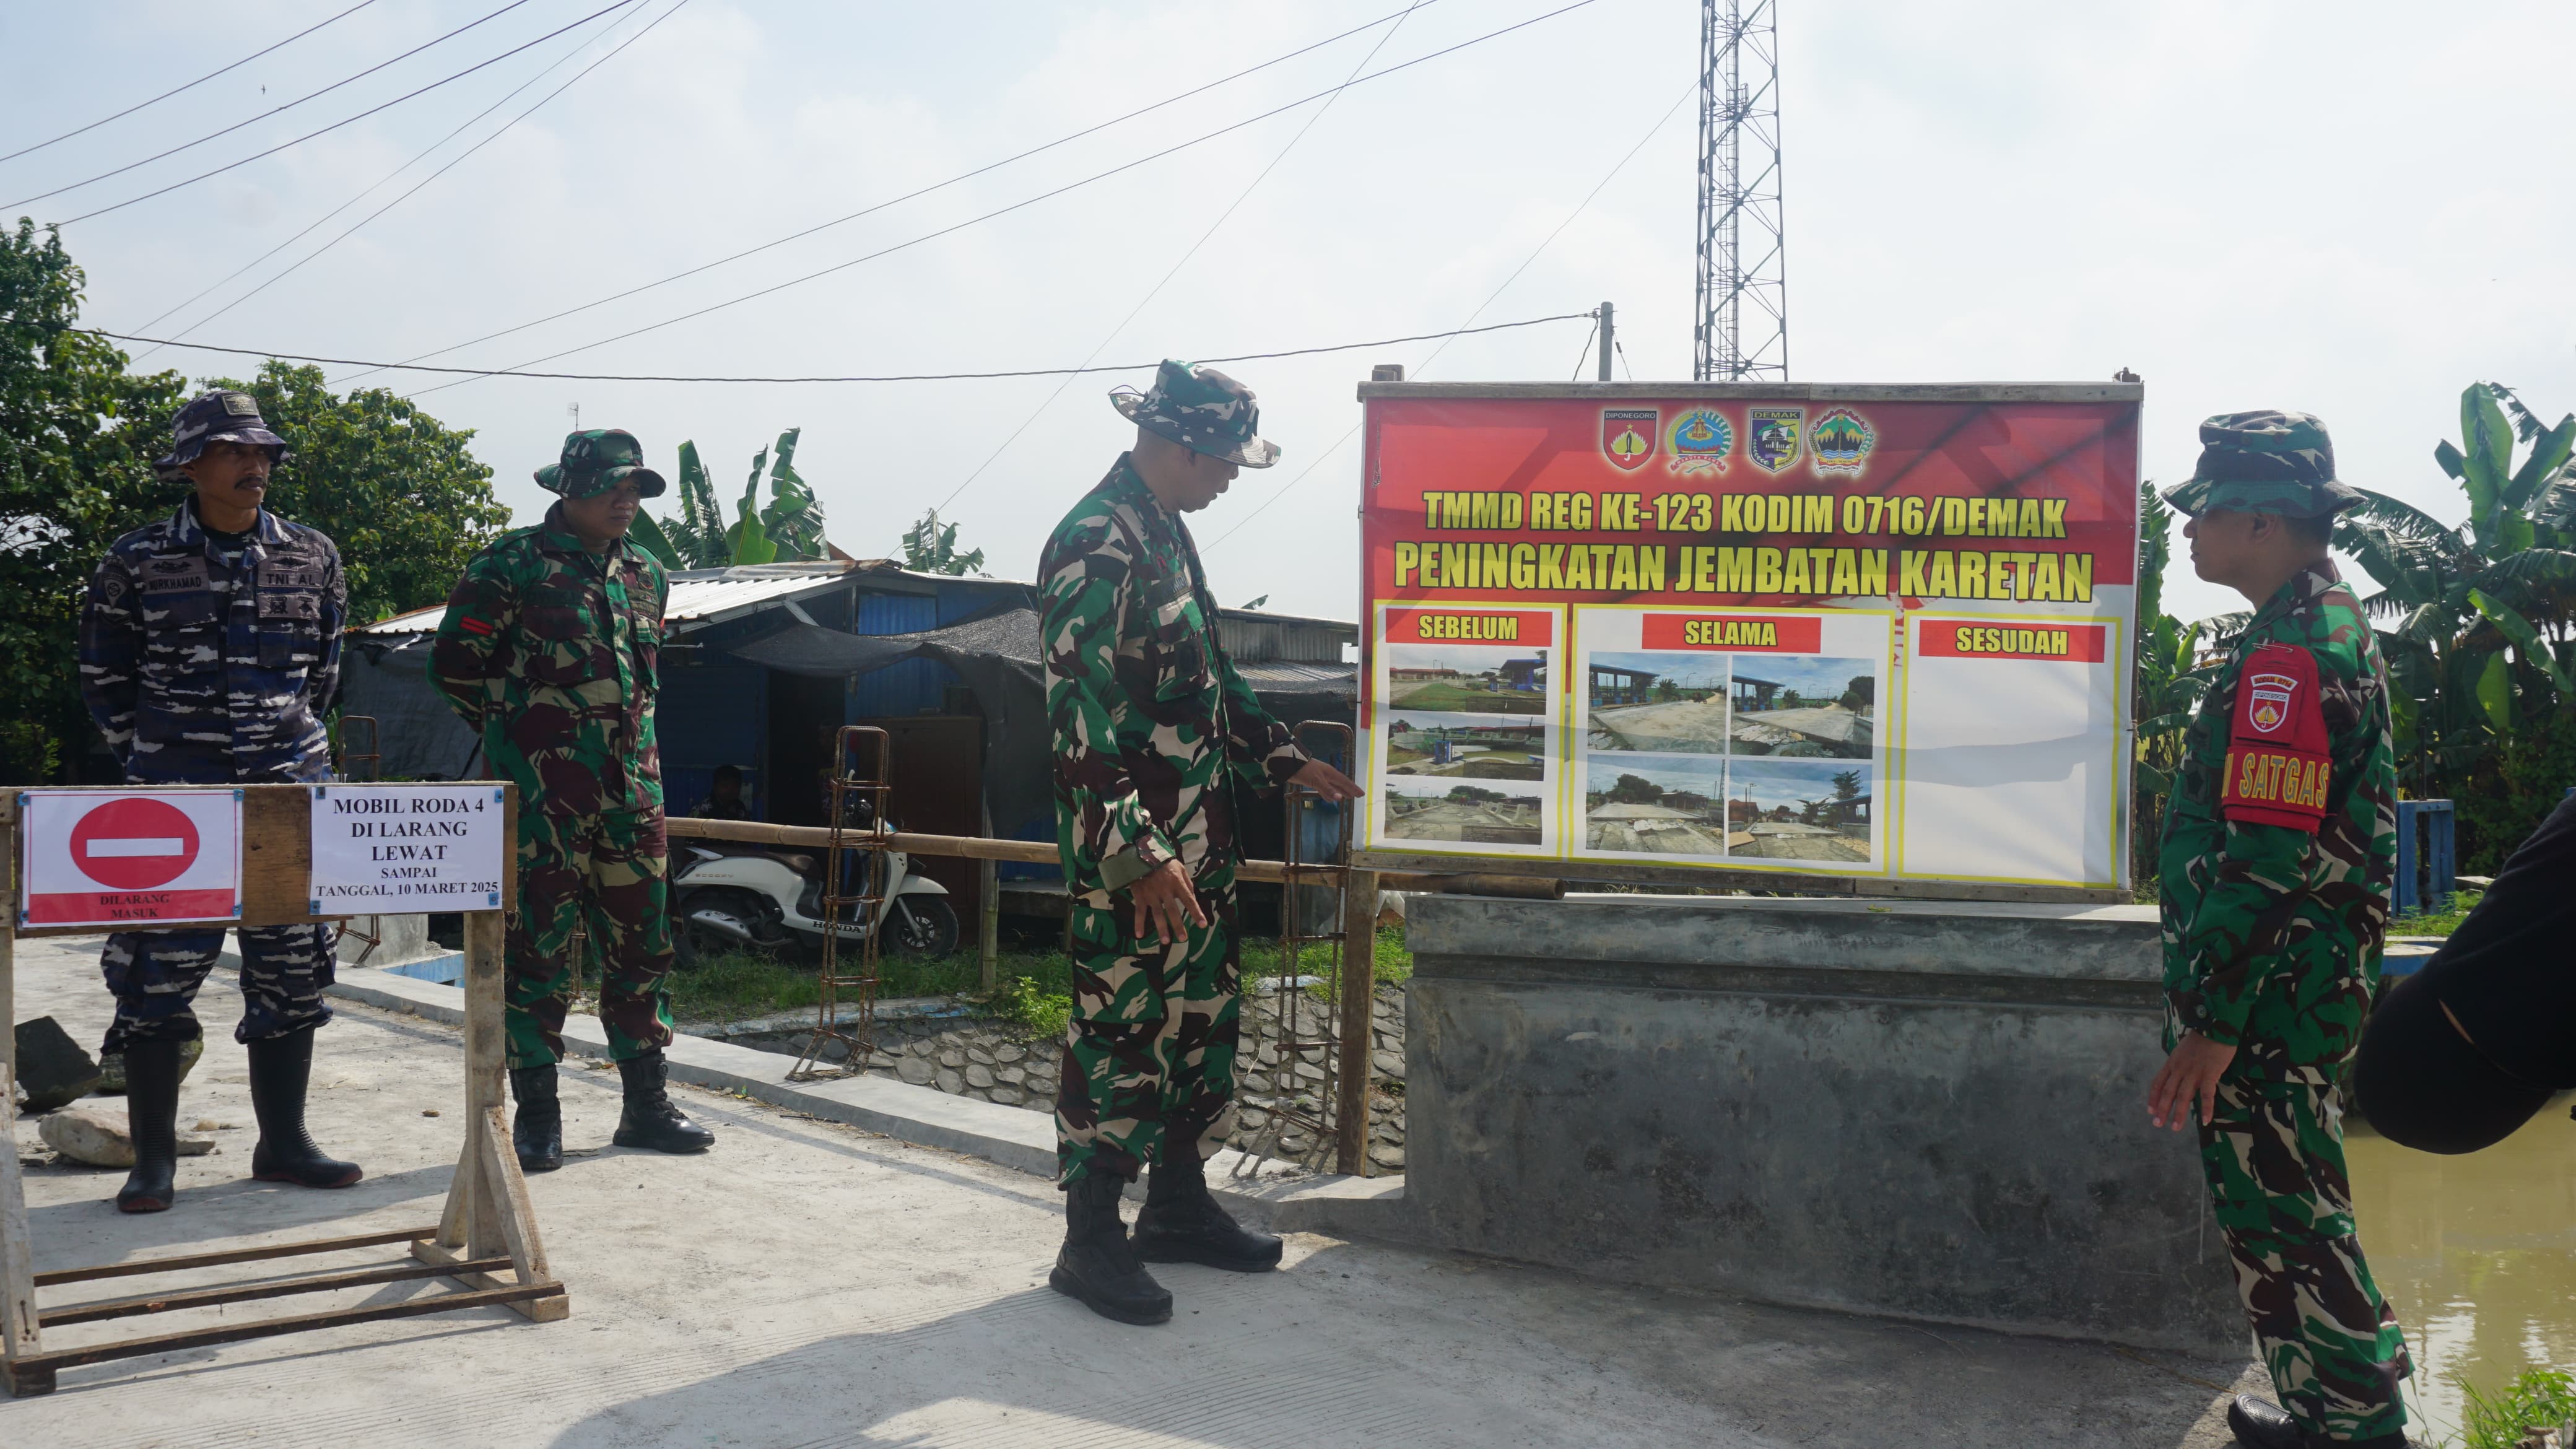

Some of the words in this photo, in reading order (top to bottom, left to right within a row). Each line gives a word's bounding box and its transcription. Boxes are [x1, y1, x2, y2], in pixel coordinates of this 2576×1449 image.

[1605, 412, 1656, 420] DIPONEGORO
[1754, 411, 1798, 419] DEMAK
[1422, 492, 1524, 529] TMMD
[1530, 493, 1593, 531] REG
[1600, 493, 1713, 533] KE-123
[1721, 494, 1834, 534] KODIM
[1842, 495, 2068, 539] 0716/DEMAK
[266, 573, 289, 585] TNI
[298, 574, 316, 585] AL
[1394, 541, 1667, 591] PENINGKATAN
[1674, 545, 1889, 596] JEMBATAN
[1899, 549, 2093, 603] KARETAN
[149, 576, 202, 591] NURKHAMAD
[1419, 614, 1518, 640] SEBELUM
[1684, 620, 1778, 646] SELAMA
[1956, 626, 2068, 655] SESUDAH
[2239, 752, 2330, 810] SATGAS
[333, 799, 405, 814] MOBIL
[411, 798, 469, 813] RODA
[474, 798, 484, 812] 4
[351, 822, 373, 837] DI
[380, 821, 468, 837] LARANG
[372, 845, 448, 861] LEWAT
[381, 867, 437, 879] SAMPAI
[316, 885, 394, 897] TANGGAL,
[398, 884, 411, 895] 10
[416, 882, 468, 894] MARET
[471, 881, 498, 892] 2025
[100, 894, 170, 905] DILARANG
[111, 908, 159, 918] MASUK
